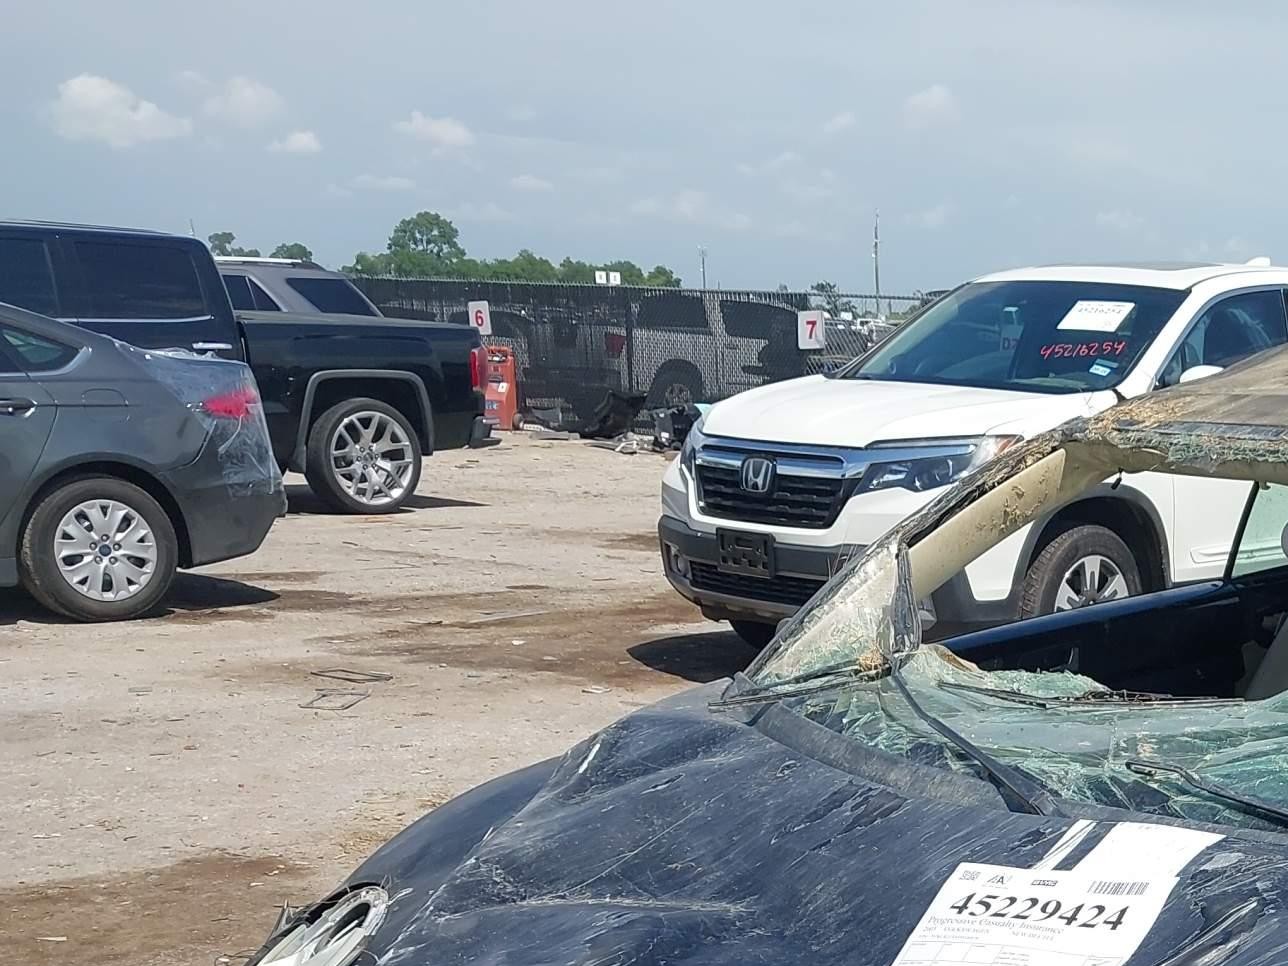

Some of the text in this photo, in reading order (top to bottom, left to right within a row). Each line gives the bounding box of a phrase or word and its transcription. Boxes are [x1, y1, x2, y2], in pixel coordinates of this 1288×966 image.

[475, 309, 485, 327] 6
[806, 320, 817, 340] 7
[1040, 341, 1126, 360] 45216254
[950, 892, 1130, 931] 45229424
